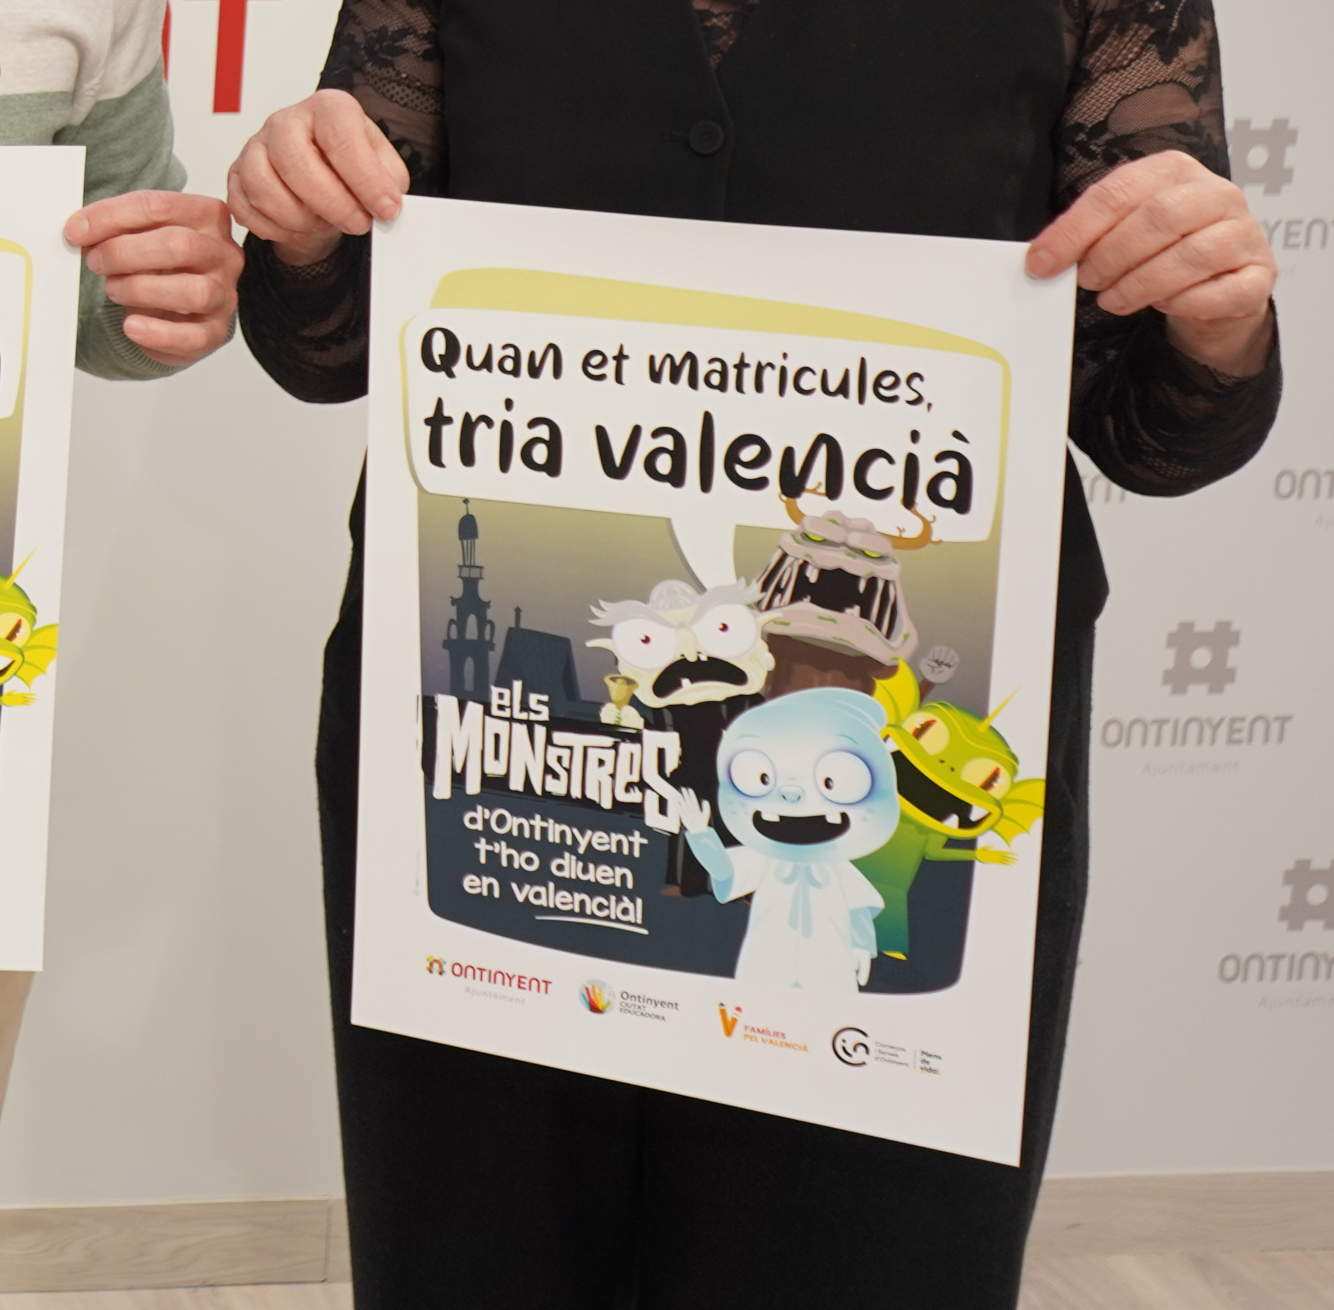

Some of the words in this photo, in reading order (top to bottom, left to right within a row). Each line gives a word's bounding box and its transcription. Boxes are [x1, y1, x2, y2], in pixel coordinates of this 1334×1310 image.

[420, 326, 562, 380] Quan
[581, 342, 630, 386] et
[648, 349, 933, 412] matricules,
[423, 395, 563, 478] tria
[594, 410, 974, 515] valencià
[1099, 712, 1295, 750] ONTINYENT
[463, 804, 648, 859] d'Ontinyent
[473, 836, 540, 872] t'ho
[550, 854, 633, 889] diuen
[462, 872, 501, 898] en
[511, 882, 644, 924] valencià!
[451, 962, 552, 995] ONTINYENT
[620, 991, 680, 1010] Ontinyent
